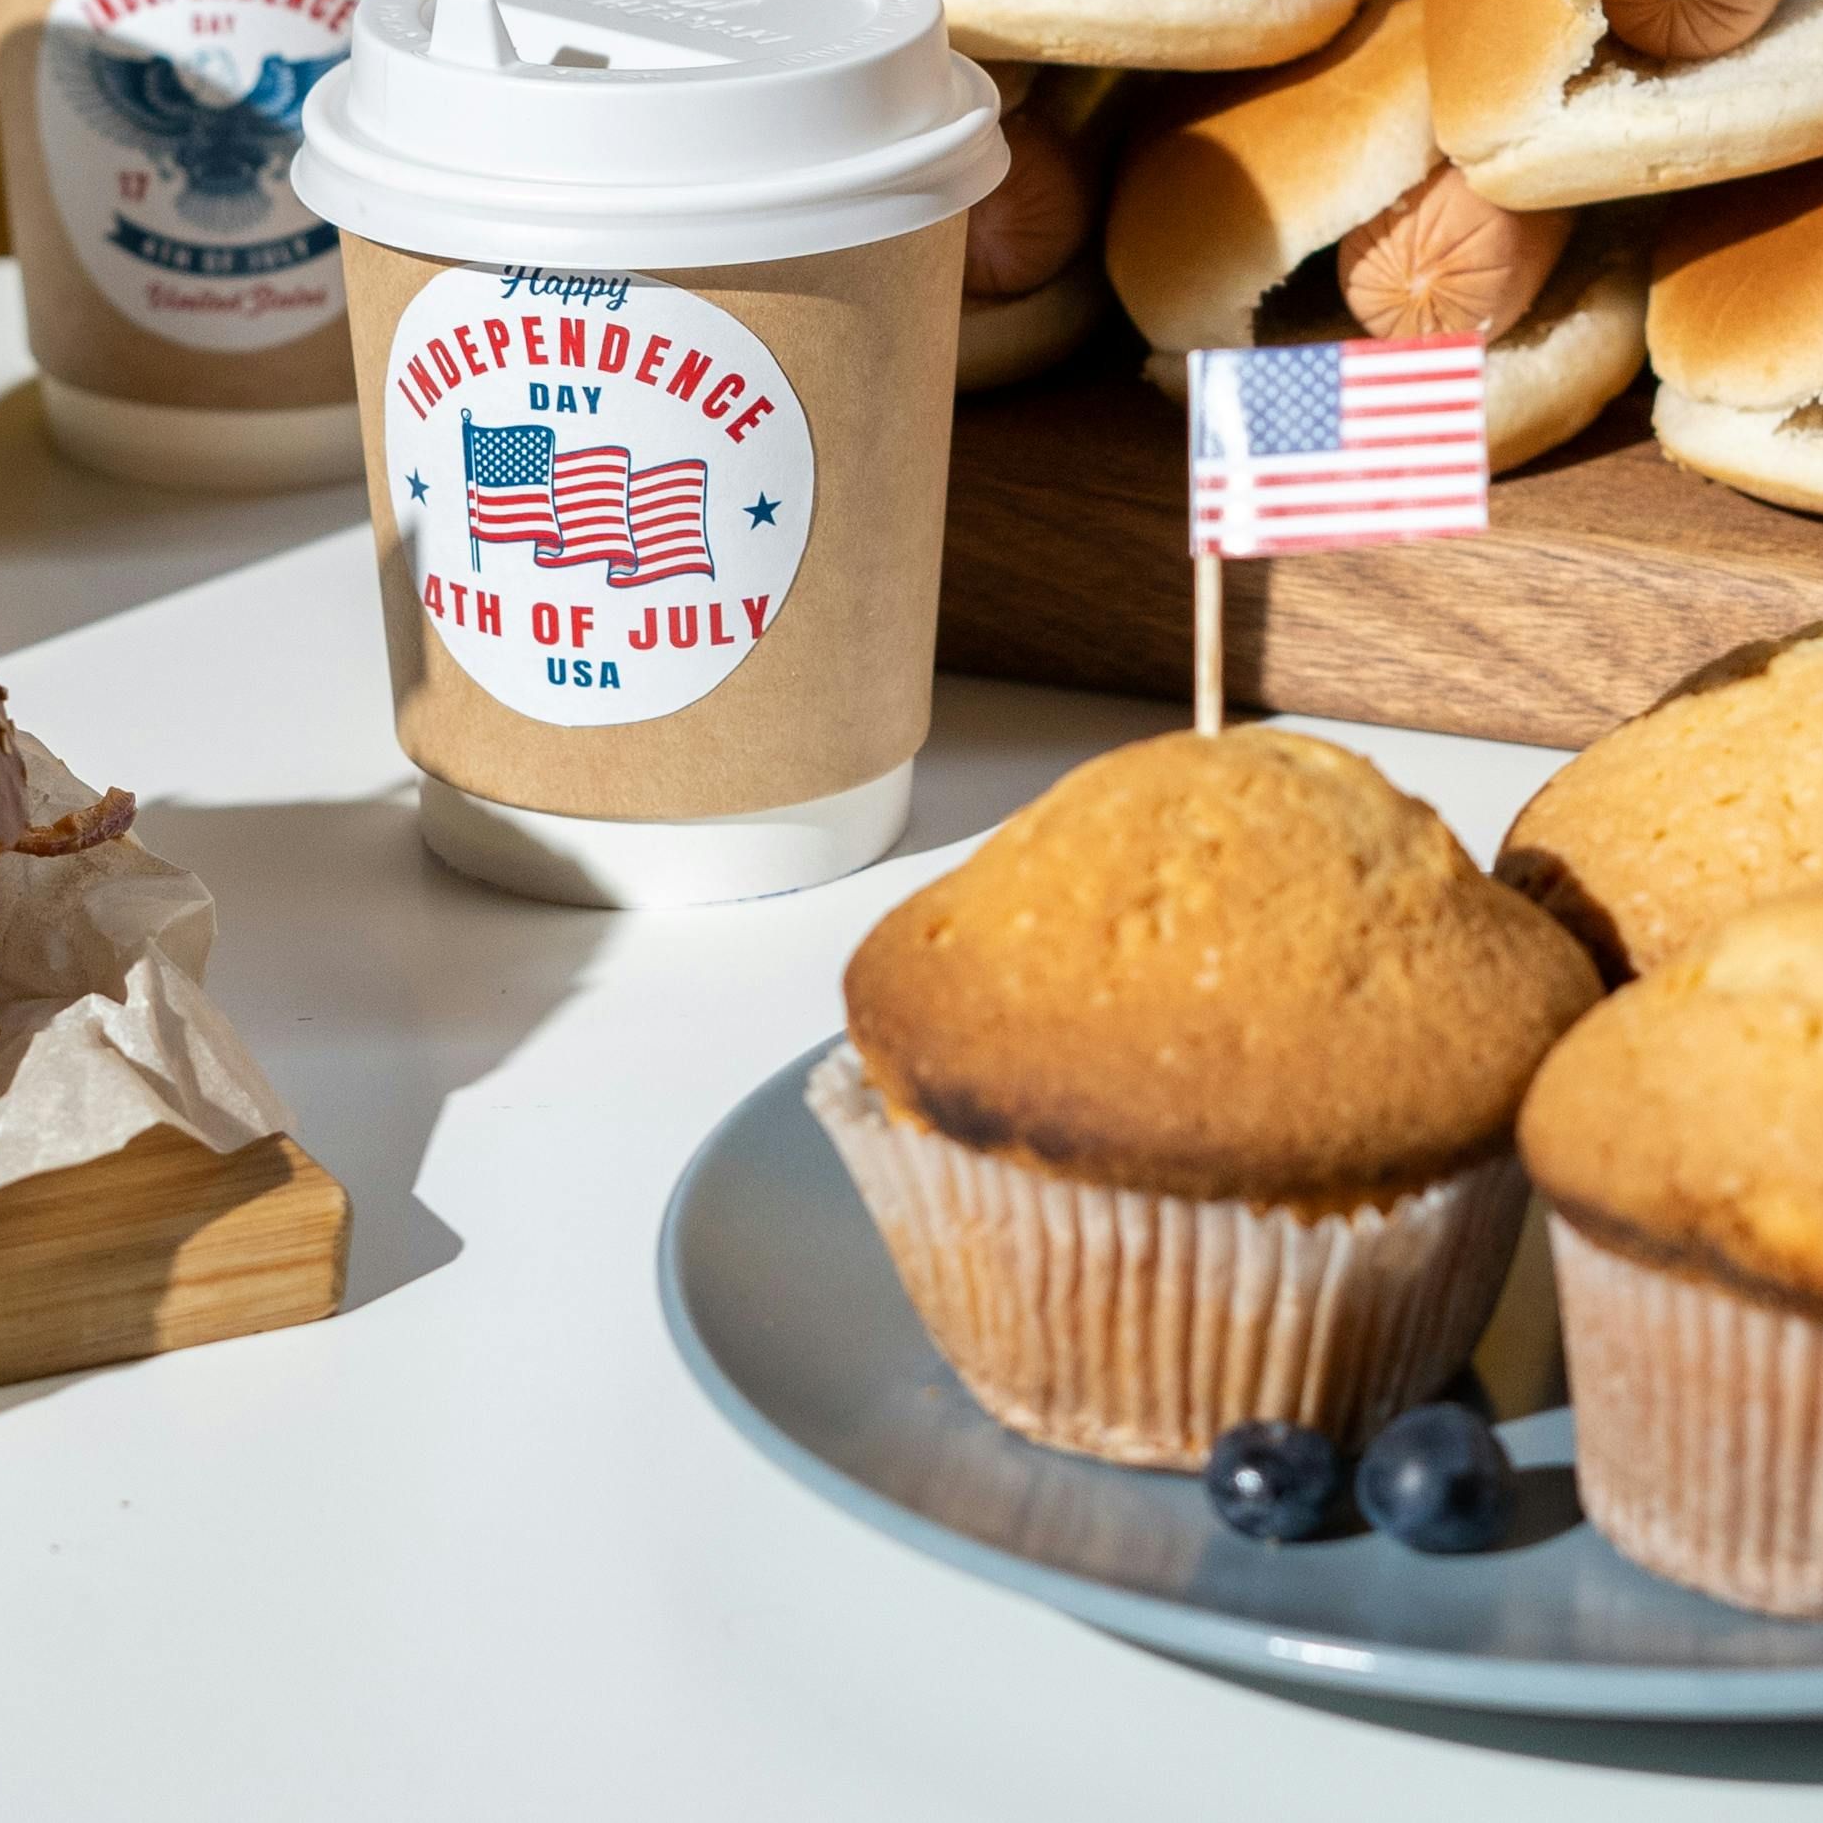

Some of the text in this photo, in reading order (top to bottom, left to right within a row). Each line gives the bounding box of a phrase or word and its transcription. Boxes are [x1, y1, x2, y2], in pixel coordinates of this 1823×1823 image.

[500, 264, 632, 311] Happy
[397, 315, 776, 444] INDEPENDENCE
[529, 382, 602, 414] DAY
[424, 573, 770, 650] 4TH OF JULY
[546, 657, 621, 689] USA
